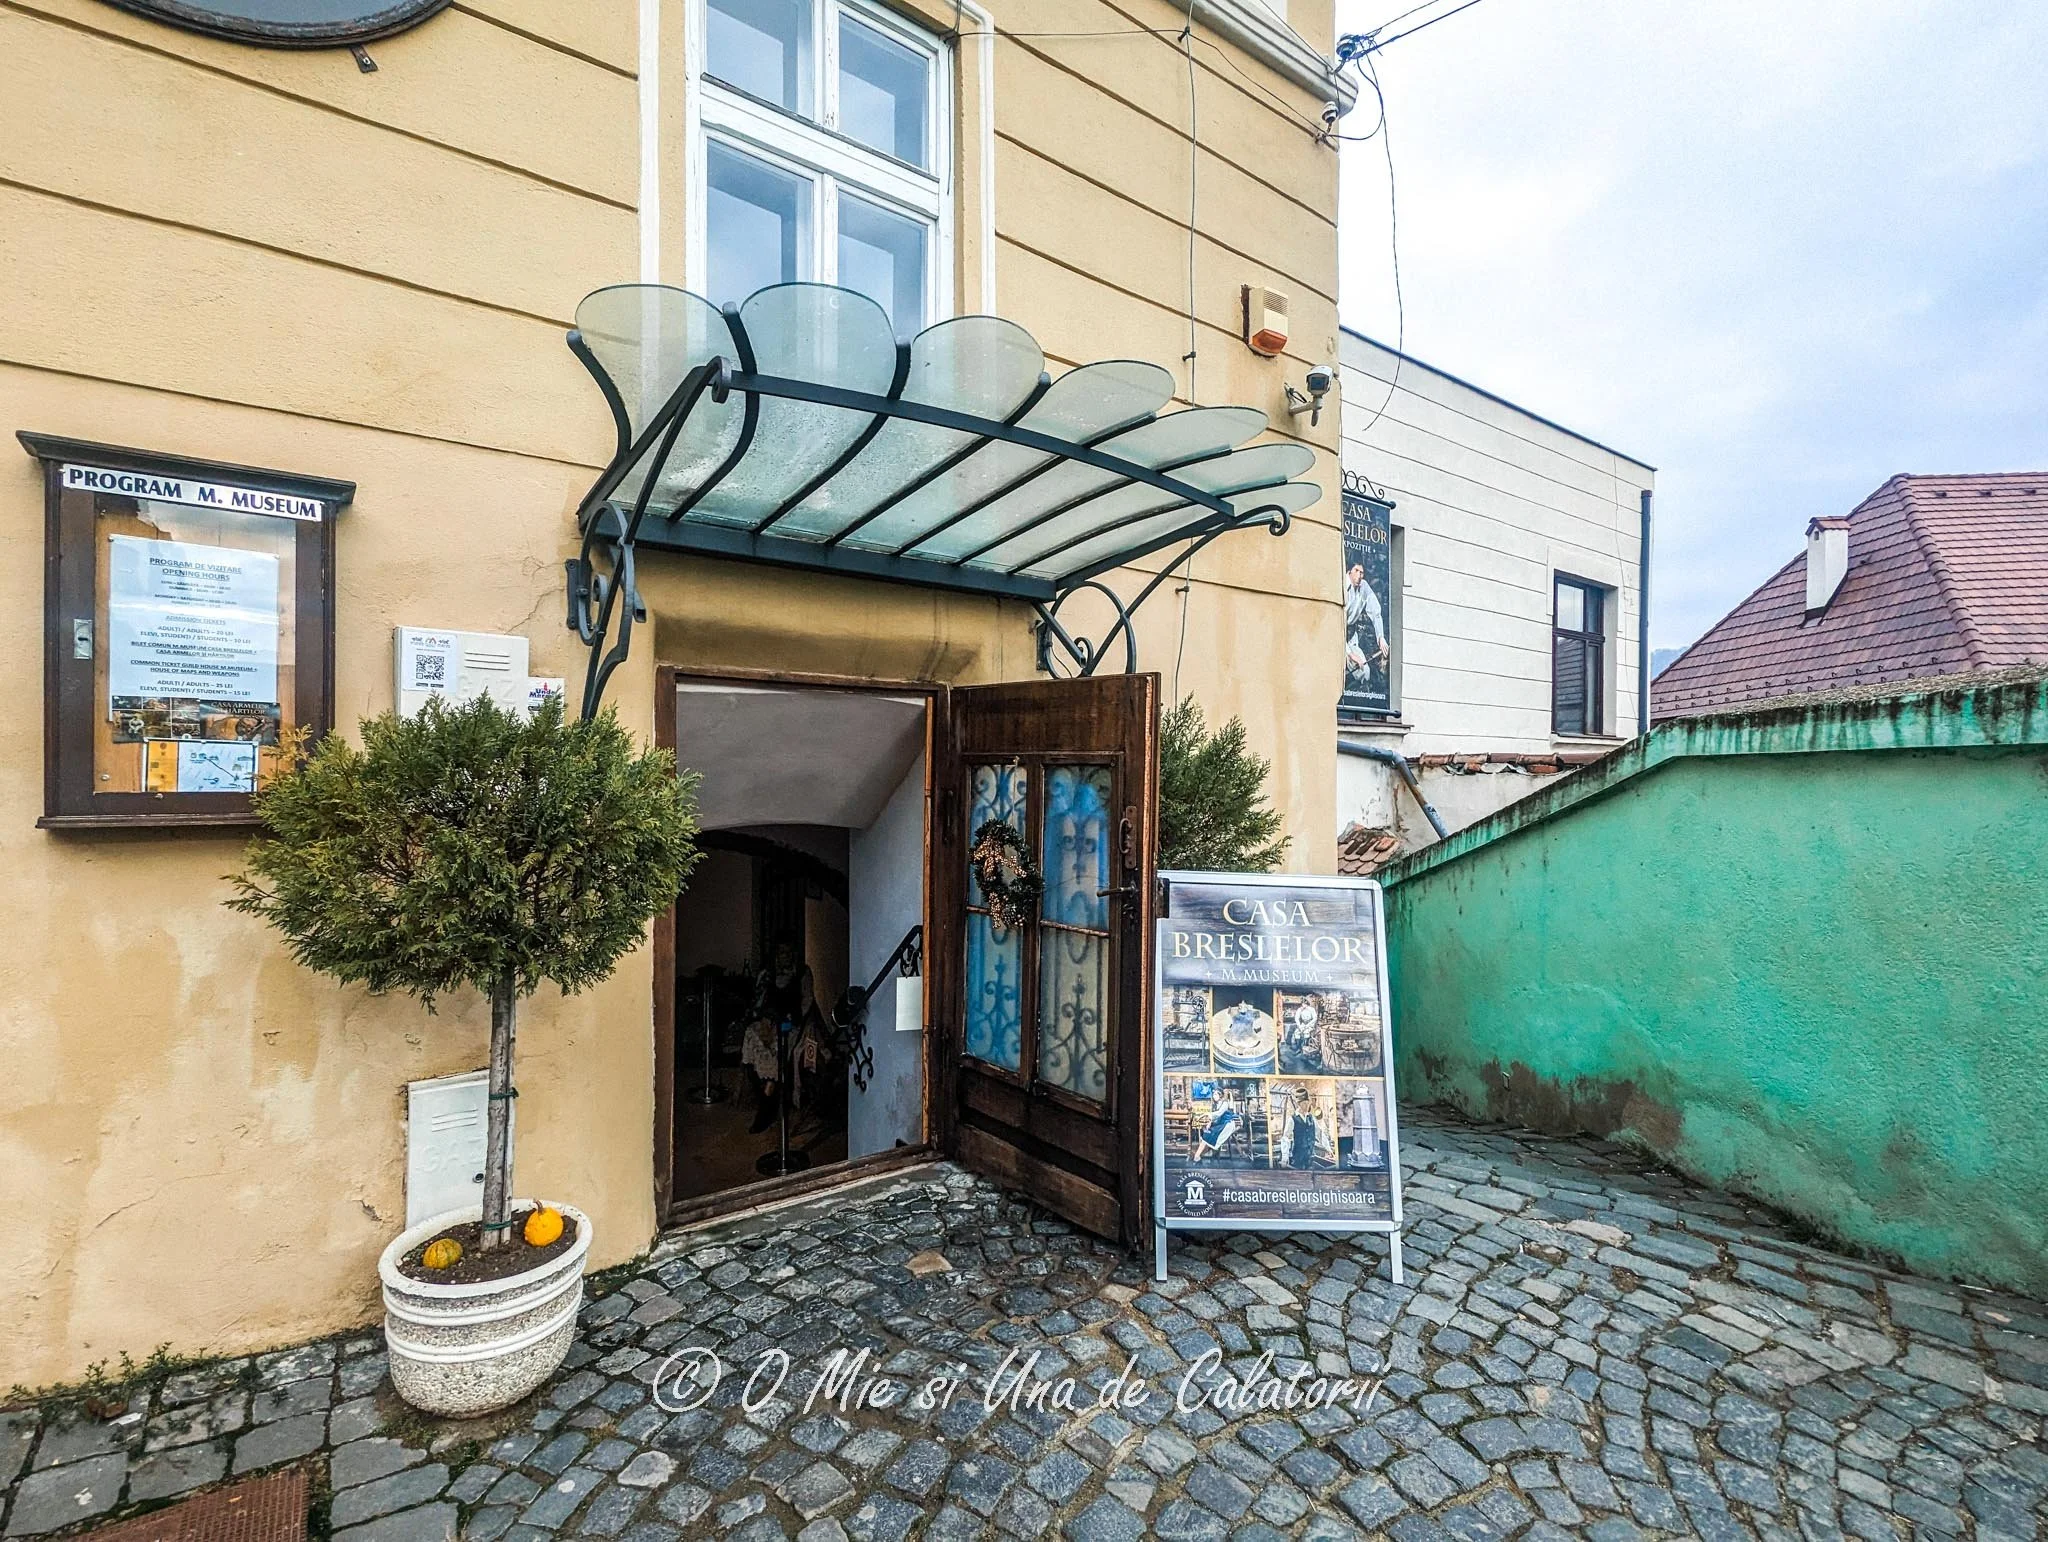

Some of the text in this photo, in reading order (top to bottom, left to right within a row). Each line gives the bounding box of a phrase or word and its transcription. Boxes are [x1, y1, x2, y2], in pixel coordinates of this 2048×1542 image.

[69, 468, 317, 517] PROGRAM M. MUSEUM
[1344, 520, 1388, 546] SLELOR
[150, 558, 193, 568] PROGRAM
[207, 564, 242, 573] VIZITARE
[162, 568, 230, 581] OPENING HOURS
[197, 635, 228, 643] STUDENTS
[1223, 897, 1313, 928] CASA
[1171, 931, 1367, 964] BRESLELOR
[1222, 968, 1320, 983] M.MUSEUM
[1187, 1186, 1204, 1200] M
[1222, 1188, 1376, 1206] #casabreslelorsighisoara
